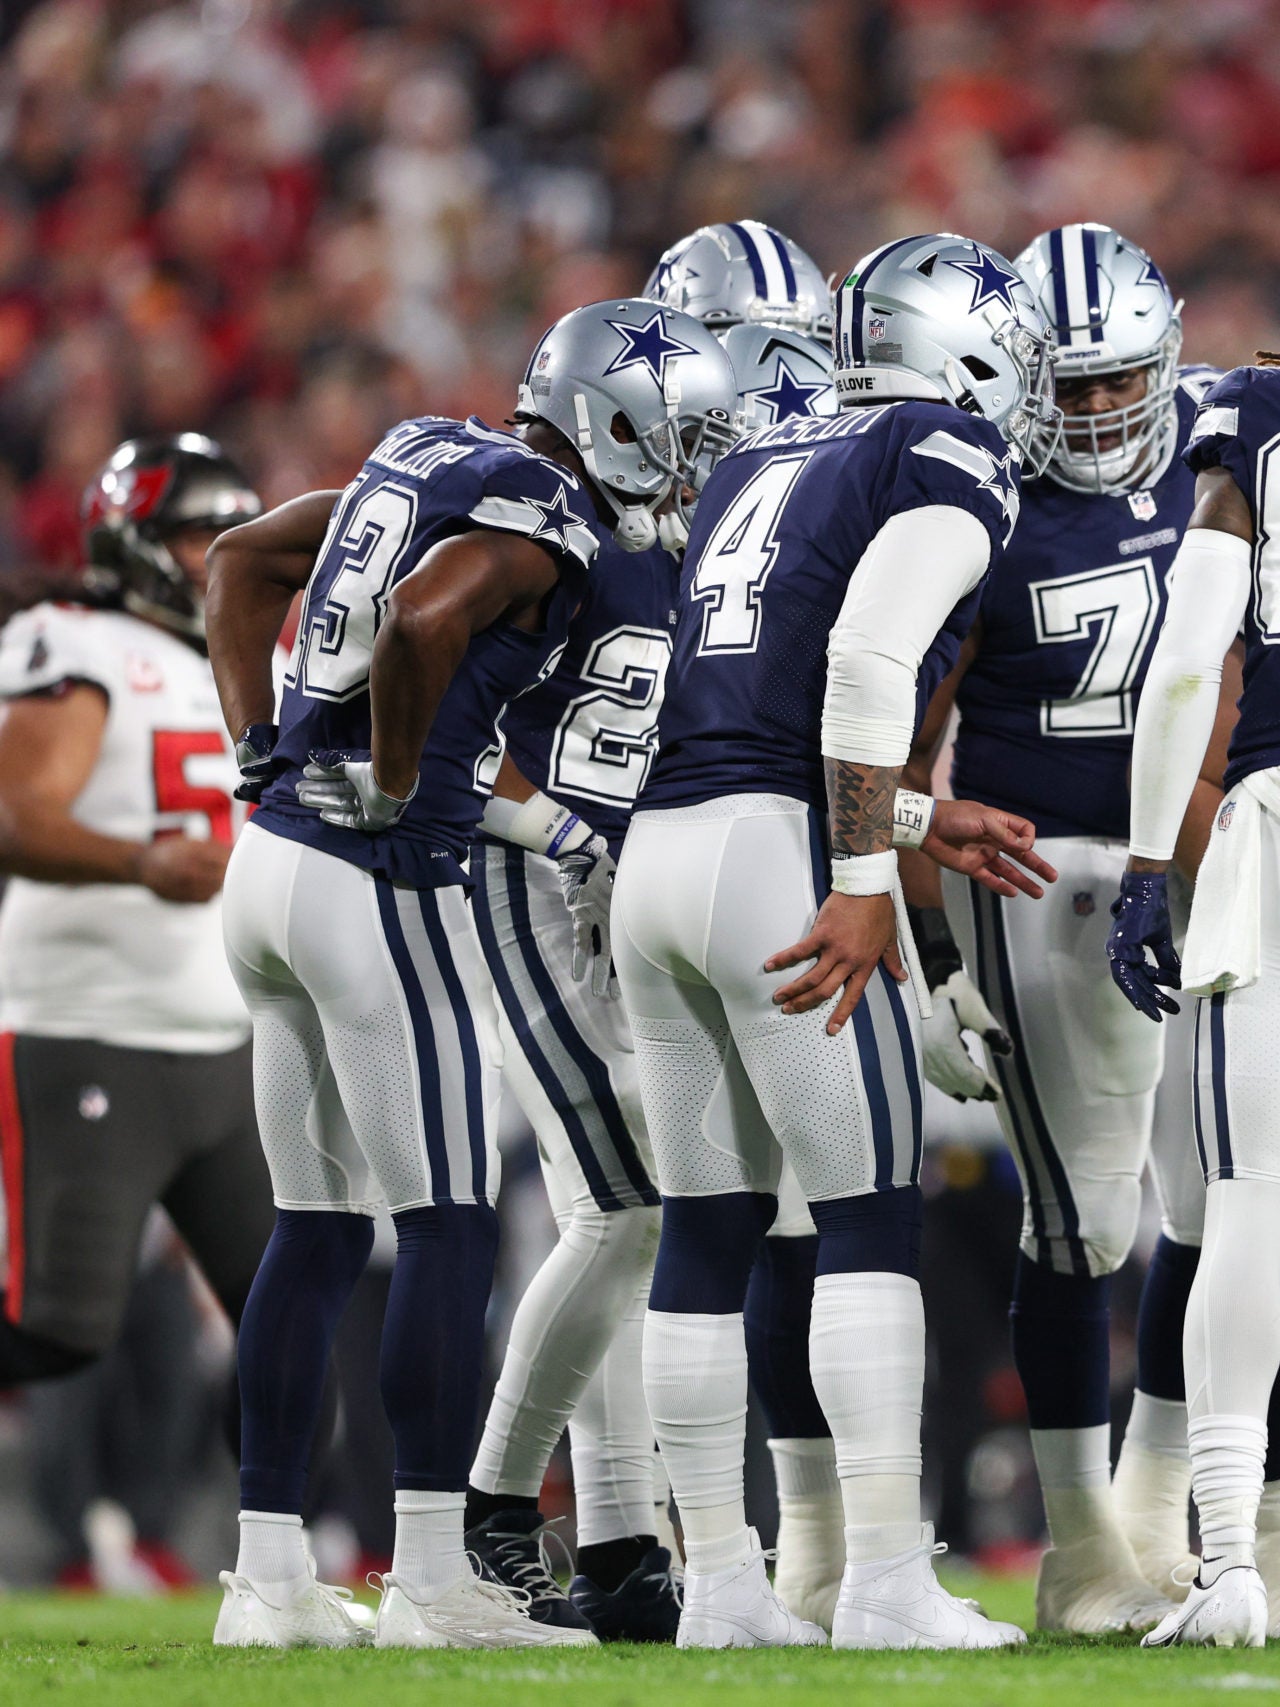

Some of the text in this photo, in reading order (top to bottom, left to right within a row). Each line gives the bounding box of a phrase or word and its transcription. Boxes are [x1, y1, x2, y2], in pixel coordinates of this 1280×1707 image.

[870, 326, 884, 338] NFL
[843, 377, 874, 391] LOVE
[369, 425, 475, 480] GALLUP
[690, 450, 816, 657] 4
[554, 832, 566, 845] WAY
